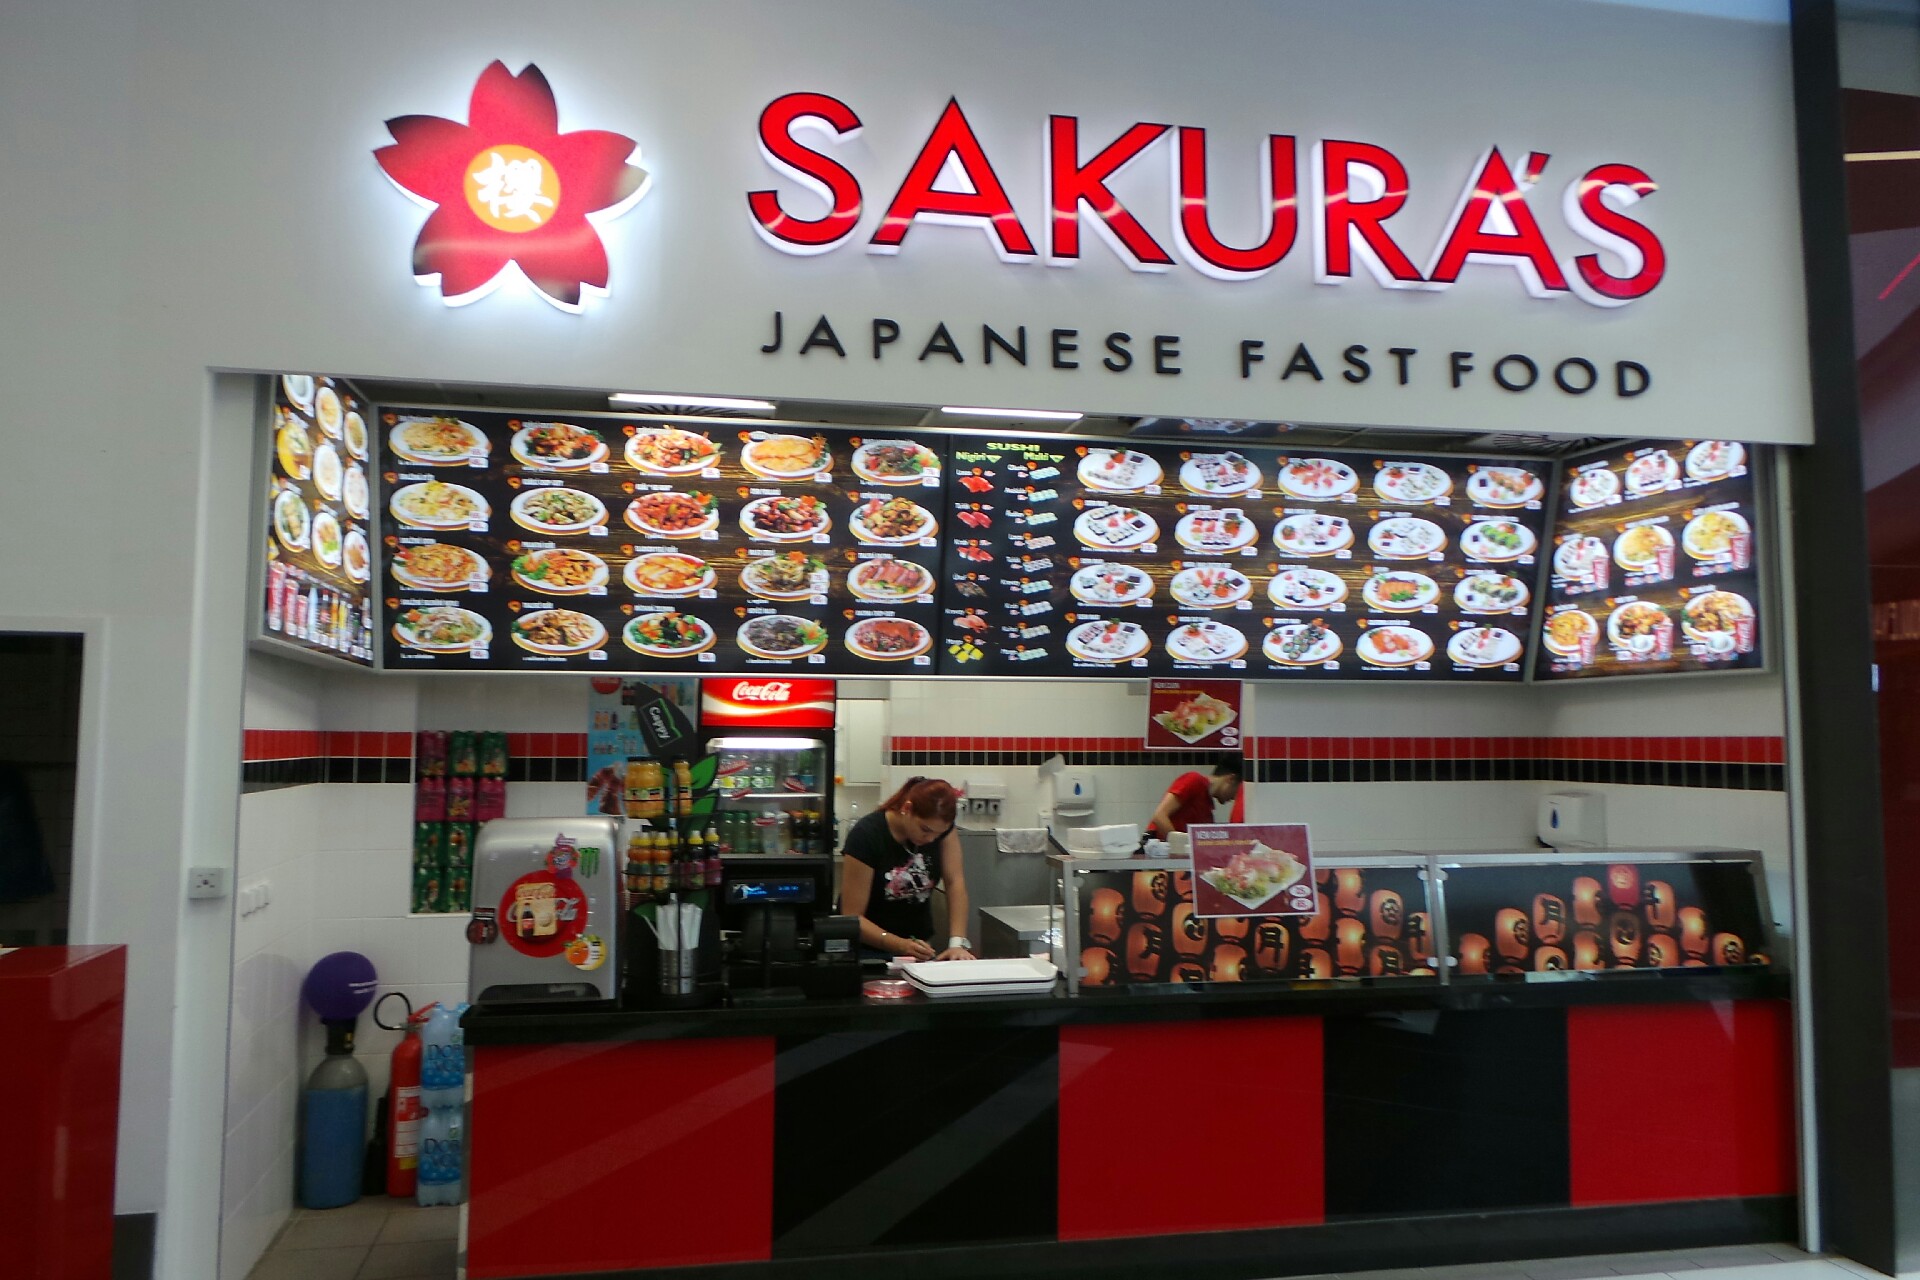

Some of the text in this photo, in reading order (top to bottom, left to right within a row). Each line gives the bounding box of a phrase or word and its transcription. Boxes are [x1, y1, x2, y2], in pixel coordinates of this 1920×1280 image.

[747, 90, 1667, 304] SAKURA'S
[761, 310, 1652, 398] JAPANESE FAST FOOD
[986, 442, 1040, 452] SUSHI
[649, 706, 671, 738] Cappy
